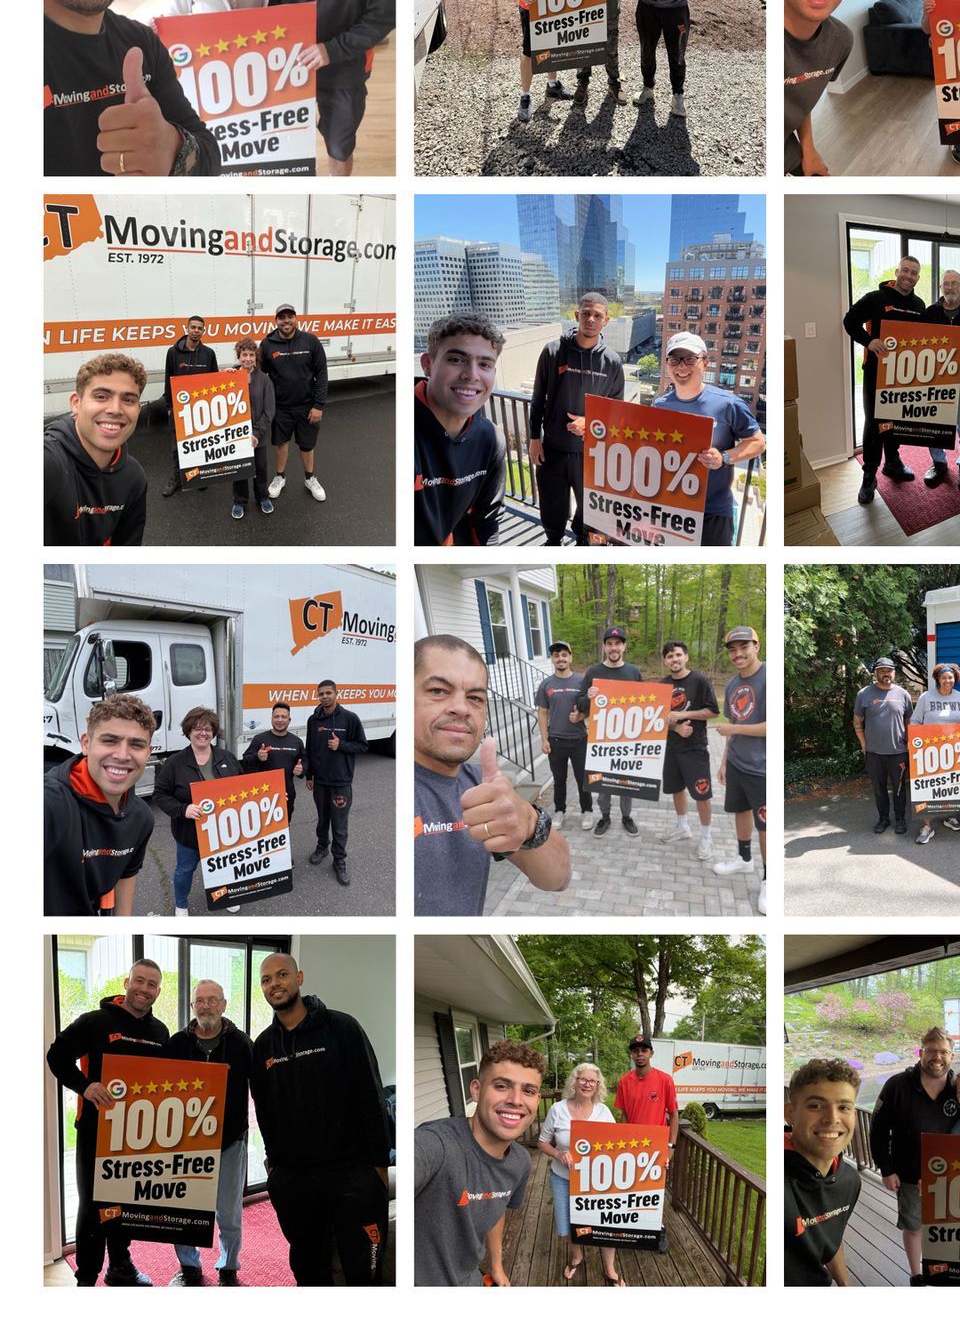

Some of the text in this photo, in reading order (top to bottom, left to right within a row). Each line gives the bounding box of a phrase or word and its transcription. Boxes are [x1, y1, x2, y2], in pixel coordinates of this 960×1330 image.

[535, 8, 604, 36] Stress-Free
[557, 26, 589, 46] Move
[221, 135, 279, 166] Move
[108, 253, 164, 264] EST. 1972
[60, 319, 372, 345] LIFE KEEPS WE MAKE IT
[883, 348, 958, 385] 100%
[880, 387, 956, 404] Stress-Free
[179, 390, 247, 435] 100%
[902, 404, 937, 418] Move
[182, 425, 250, 454] Stress-Free
[205, 442, 236, 463] Move
[589, 441, 700, 496] 100%
[589, 491, 696, 534] Stress-Free
[616, 519, 665, 546] Move
[303, 600, 333, 632] CT
[342, 637, 354, 645] EST.
[268, 689, 386, 702] WHEN KEEPS YOU
[594, 705, 664, 740] 100%
[591, 743, 661, 757] Stress-Free
[610, 759, 642, 770] Move
[932, 786, 959, 799] Move
[201, 793, 283, 851] 100%
[207, 833, 286, 872] Stress-Free
[233, 858, 270, 880] Move
[674, 1055, 688, 1067] CT
[106, 1096, 217, 1151] 100%
[101, 1154, 214, 1180] Stress-Free
[575, 1151, 661, 1192] 100%
[134, 1180, 186, 1201] Move
[575, 1193, 659, 1211] Stress-Free
[122, 1211, 209, 1226] MovingandStorage.com
[600, 1211, 638, 1224] Move
